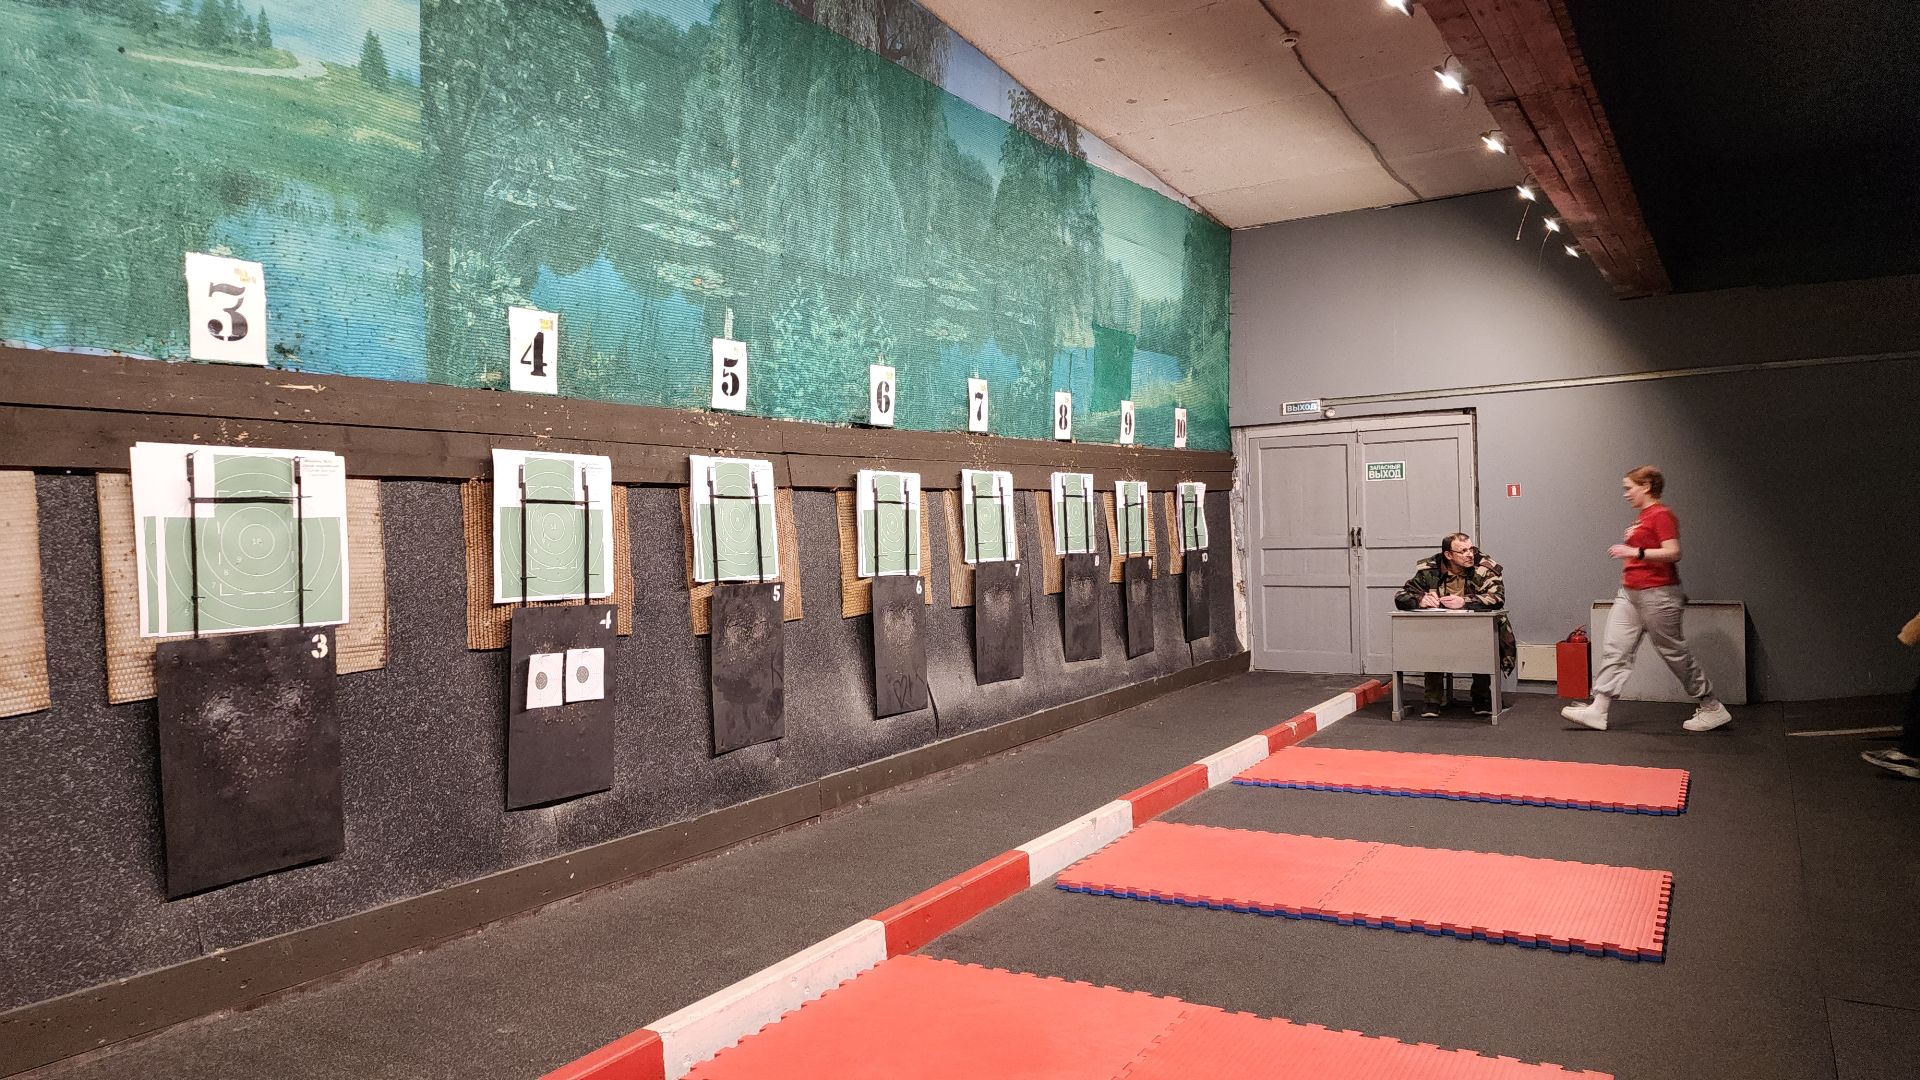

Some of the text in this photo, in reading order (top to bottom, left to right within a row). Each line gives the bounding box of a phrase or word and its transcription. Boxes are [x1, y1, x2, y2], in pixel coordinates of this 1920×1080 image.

[208, 282, 248, 341] 3
[520, 331, 548, 377] 4
[721, 357, 740, 397] 5
[876, 381, 891, 414] 6
[975, 392, 984, 421] 7
[1286, 403, 1318, 412] ВЫХОД
[1059, 404, 1068, 430] 8
[1124, 411, 1132, 435] 9
[1176, 418, 1186, 438] 10
[1368, 470, 1401, 479] ВЫХОД
[1015, 563, 1020, 576] 7
[773, 585, 781, 601] 5
[916, 580, 922, 595] 6
[599, 610, 612, 630] 4
[311, 633, 328, 659] 3
